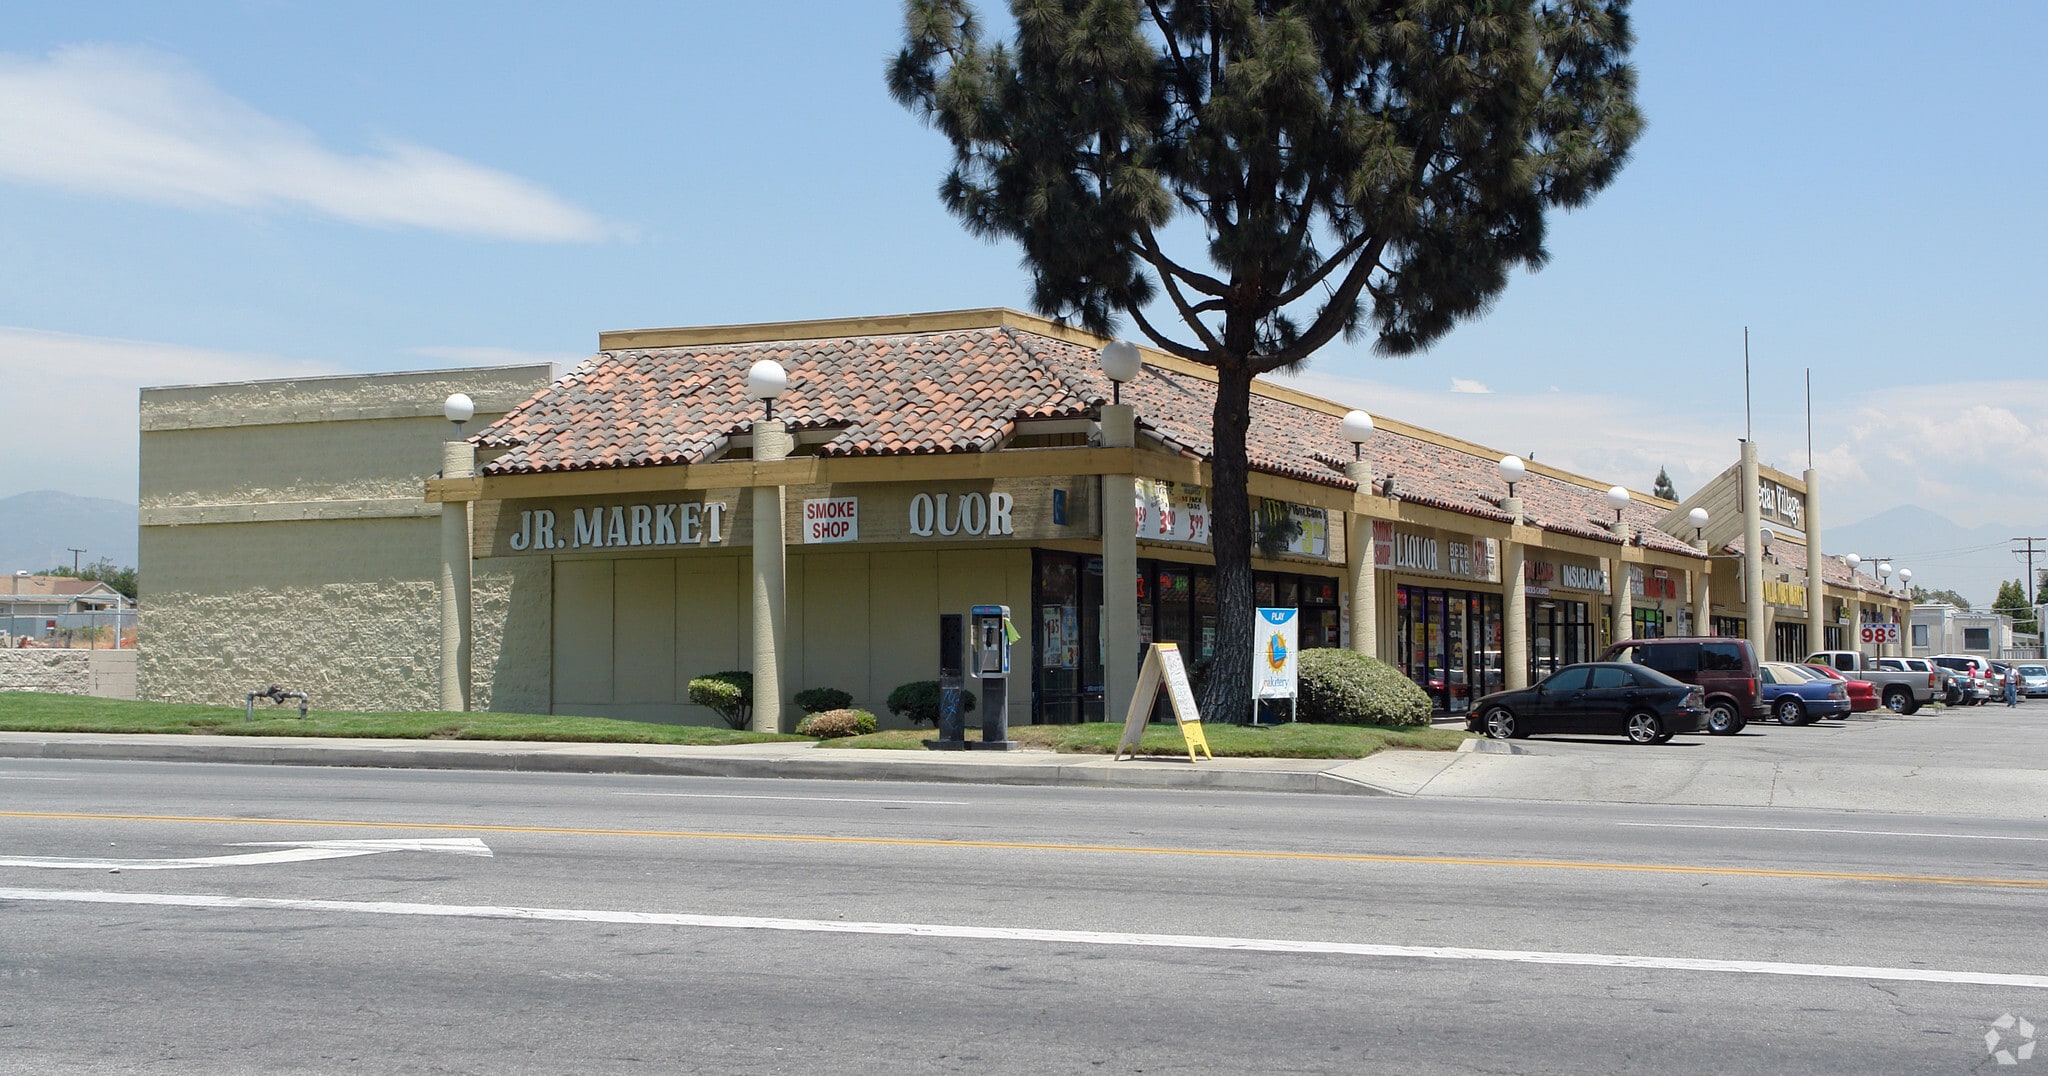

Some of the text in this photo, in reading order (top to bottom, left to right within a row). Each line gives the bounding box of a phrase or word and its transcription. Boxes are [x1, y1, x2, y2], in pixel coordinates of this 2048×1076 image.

[807, 501, 855, 519] SMOKE
[1758, 480, 1800, 525] edar Village
[909, 492, 1014, 537] QUOR
[509, 502, 727, 550] JR. MARKET
[813, 521, 850, 539] SHOP
[1372, 520, 1393, 542] SMOKE
[1375, 544, 1391, 566] SHOP
[1396, 533, 1438, 571] LIQUOR
[1449, 542, 1469, 558] BEER
[1450, 558, 1470, 575] WNE
[1563, 564, 1607, 591] INSURANCE
[1271, 612, 1285, 621] PLAY
